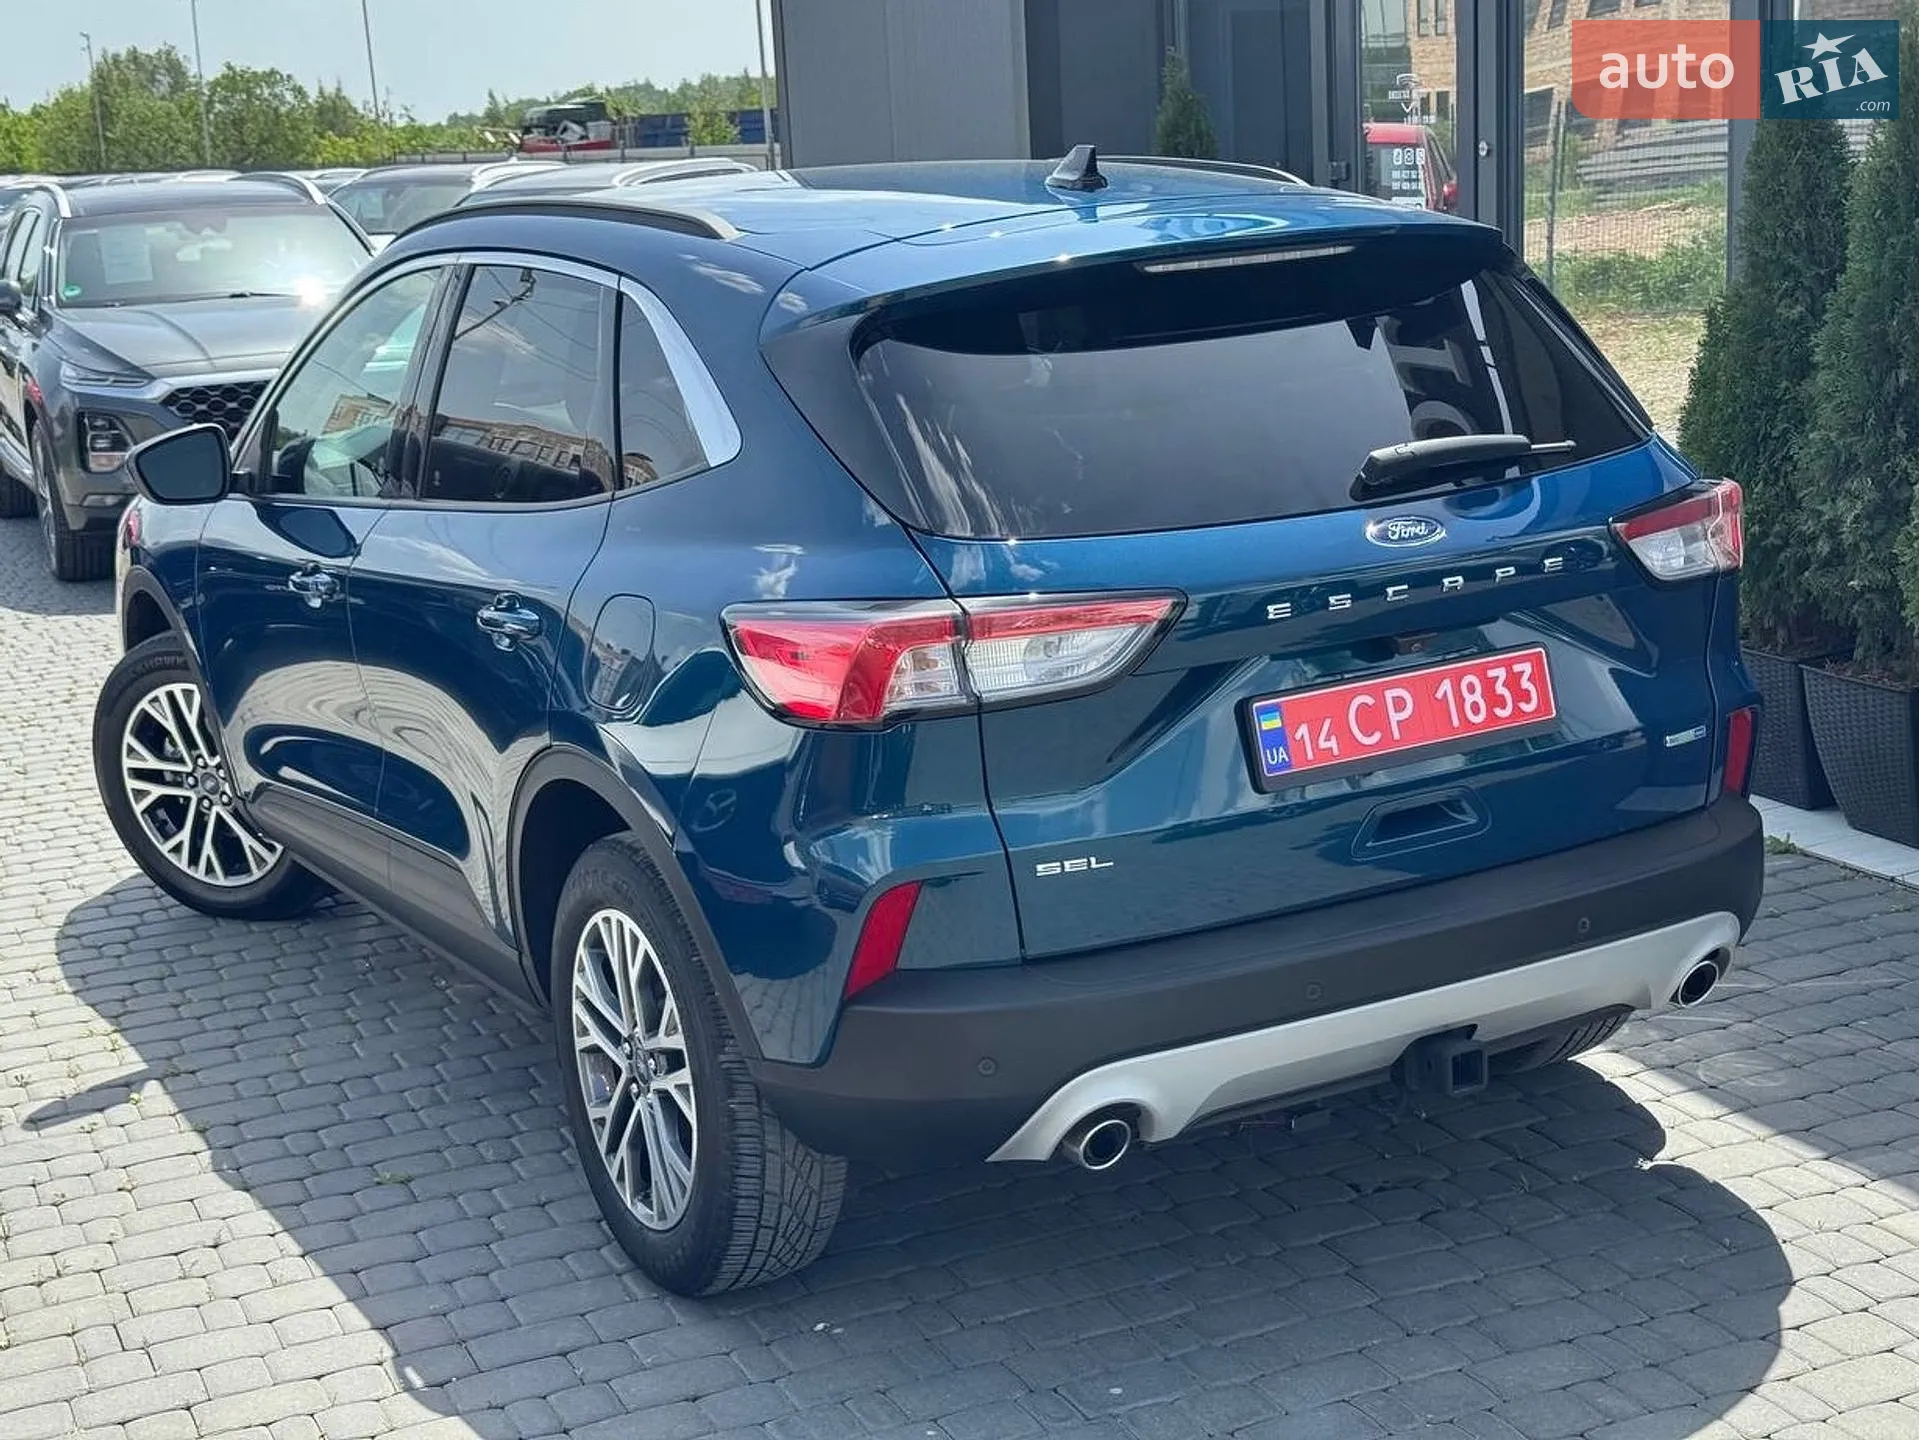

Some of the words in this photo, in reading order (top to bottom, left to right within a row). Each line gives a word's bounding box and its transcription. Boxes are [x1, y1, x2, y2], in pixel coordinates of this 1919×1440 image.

[1387, 520, 1429, 540] Ford
[1266, 557, 1564, 619] ESCAPE
[1294, 718, 1339, 761] 14
[1348, 688, 1414, 746] CP
[1434, 662, 1539, 728] 1833
[1266, 747, 1289, 765] UA
[1035, 856, 1114, 877] SEL
